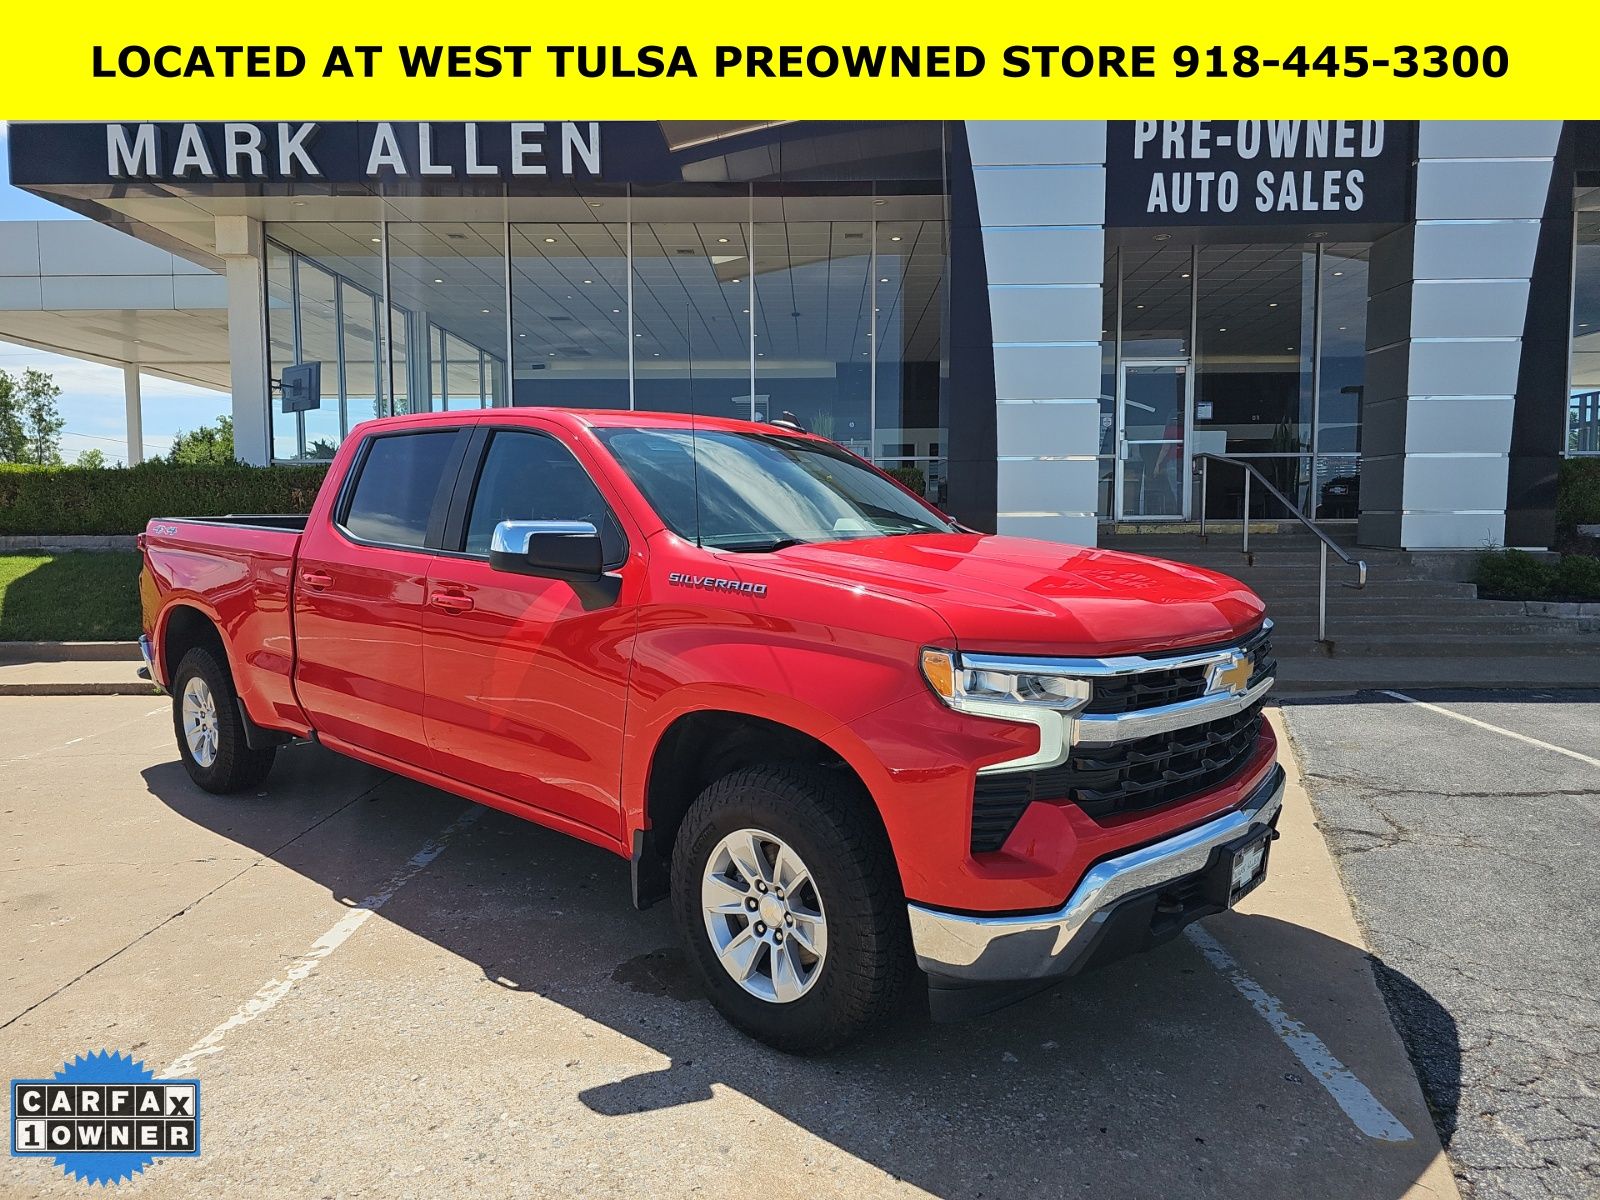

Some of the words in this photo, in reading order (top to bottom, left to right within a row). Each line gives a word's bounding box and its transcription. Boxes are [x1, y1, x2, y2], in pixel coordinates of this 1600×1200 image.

[106, 122, 320, 177] MARK
[365, 122, 601, 175] ALLEN
[1133, 119, 1385, 160] PRE-OWNED
[1146, 170, 1239, 213] AUTO
[1255, 169, 1365, 213] SALES
[668, 572, 767, 594] SILVERADO
